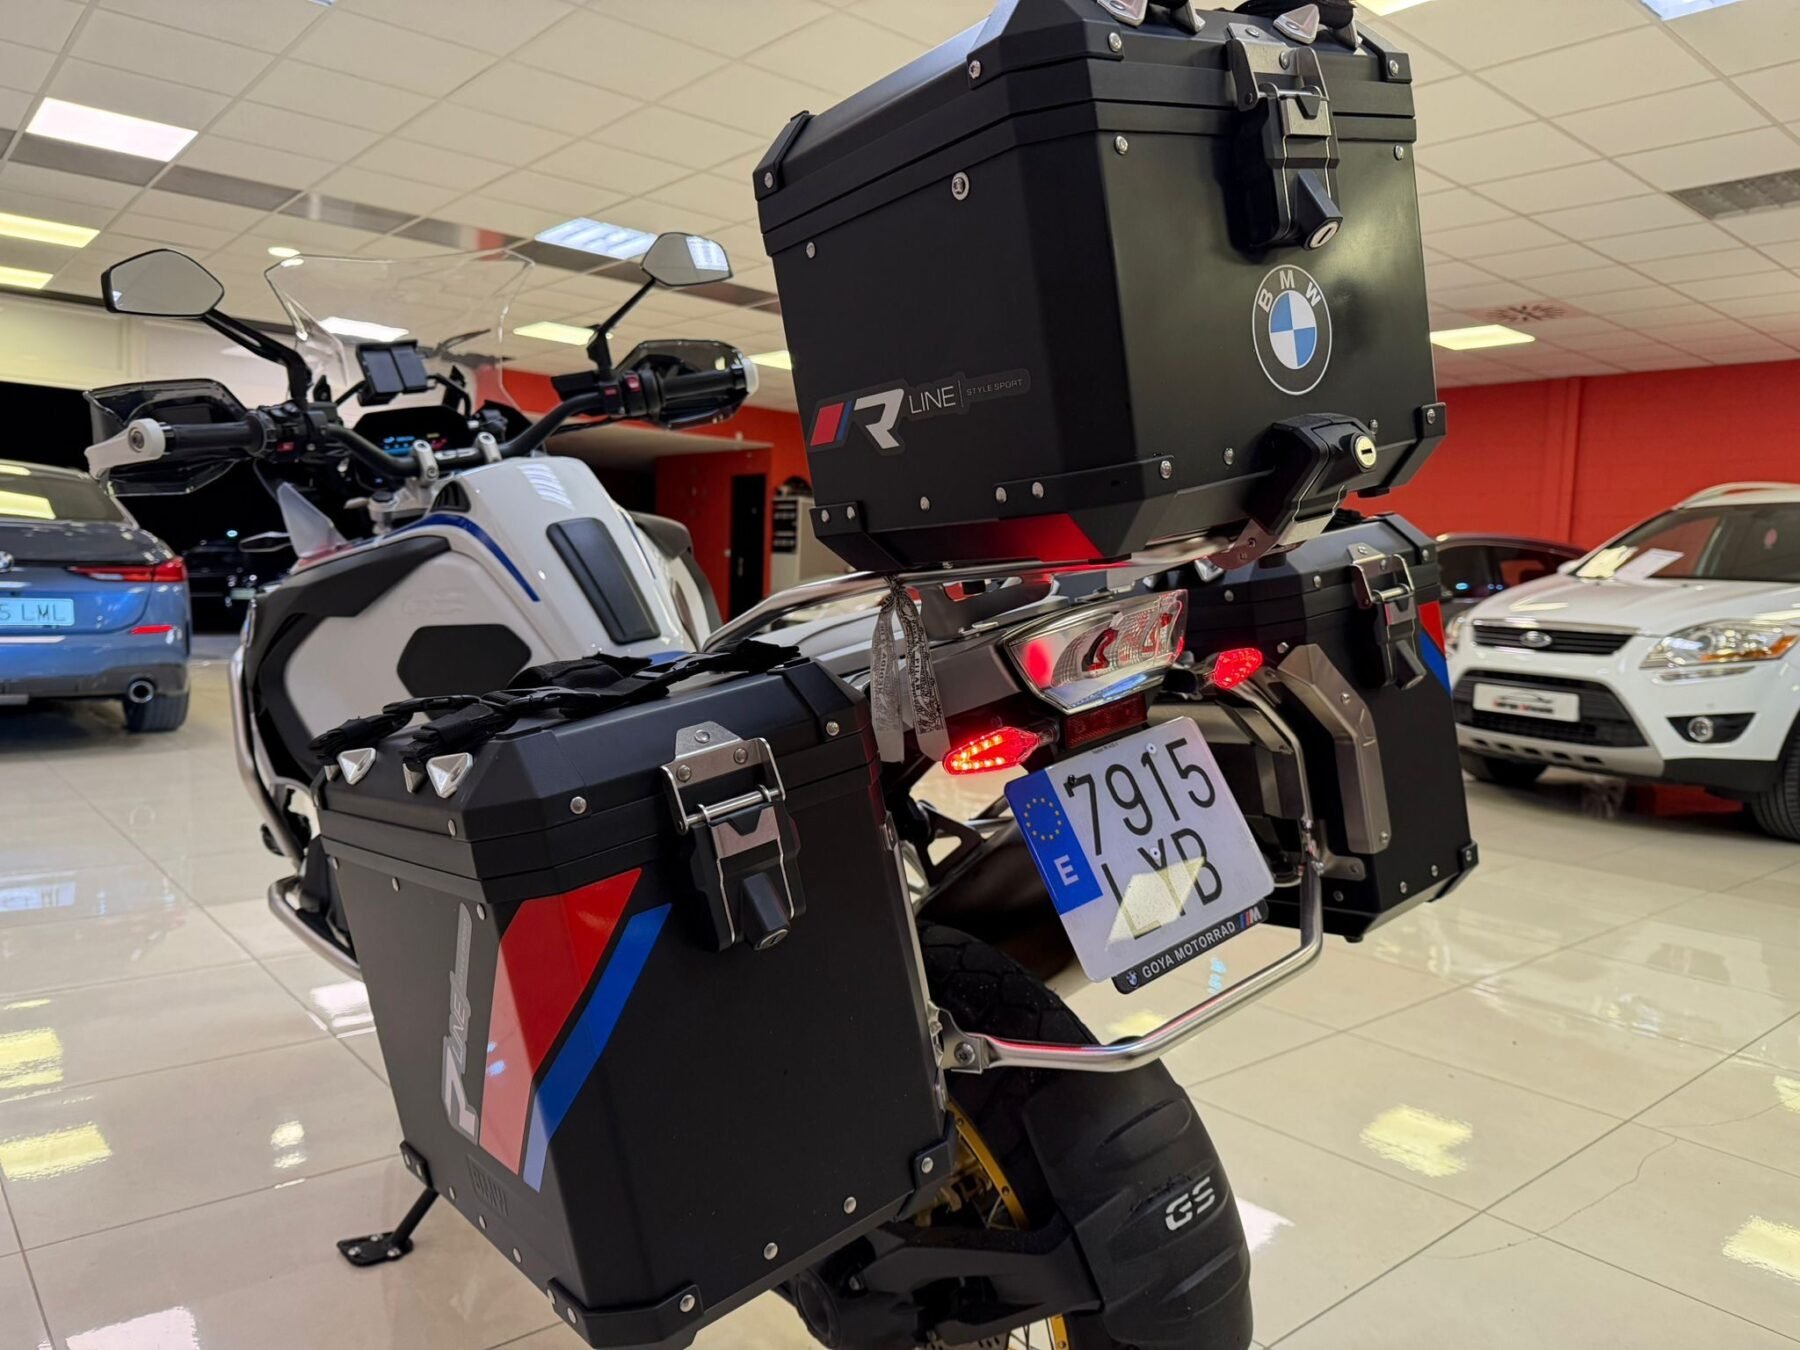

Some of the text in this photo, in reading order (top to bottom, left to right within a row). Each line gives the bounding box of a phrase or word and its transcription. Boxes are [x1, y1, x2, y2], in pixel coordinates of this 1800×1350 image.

[1258, 269, 1322, 313] BMW
[854, 379, 1023, 450] R LINE STYLE SPORT
[21, 604, 67, 622] LML
[1063, 737, 1217, 856] 7915
[1054, 855, 1080, 887] E
[1101, 827, 1224, 940] LYB
[1142, 954, 1175, 978] GOYA
[1174, 921, 1236, 961] MOTORRAD
[451, 992, 466, 1065] LINE
[1165, 1176, 1216, 1231] GS
